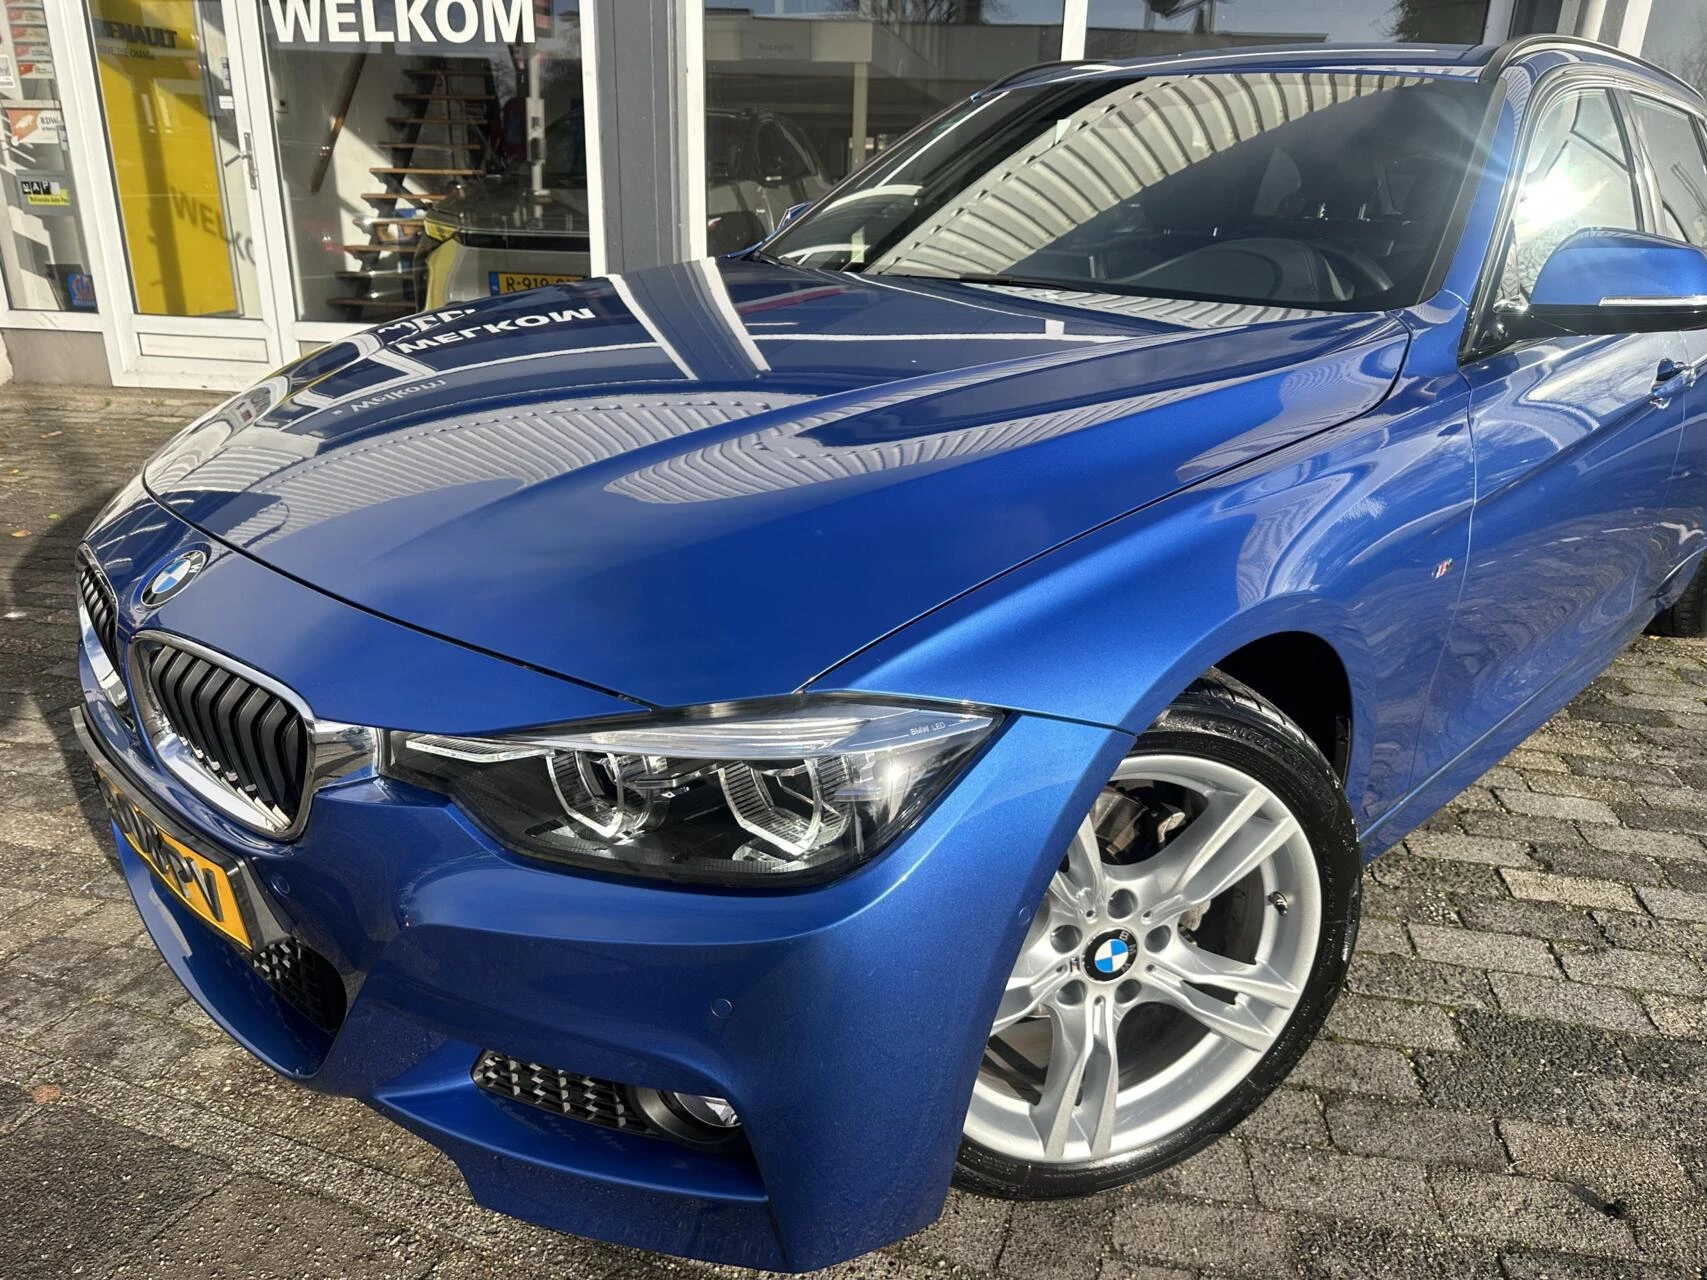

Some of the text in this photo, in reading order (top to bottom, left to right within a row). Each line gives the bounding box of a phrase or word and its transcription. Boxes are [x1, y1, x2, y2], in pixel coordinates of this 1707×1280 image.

[269, 0, 536, 43] WELKOM
[910, 722, 946, 736] BMW LED
